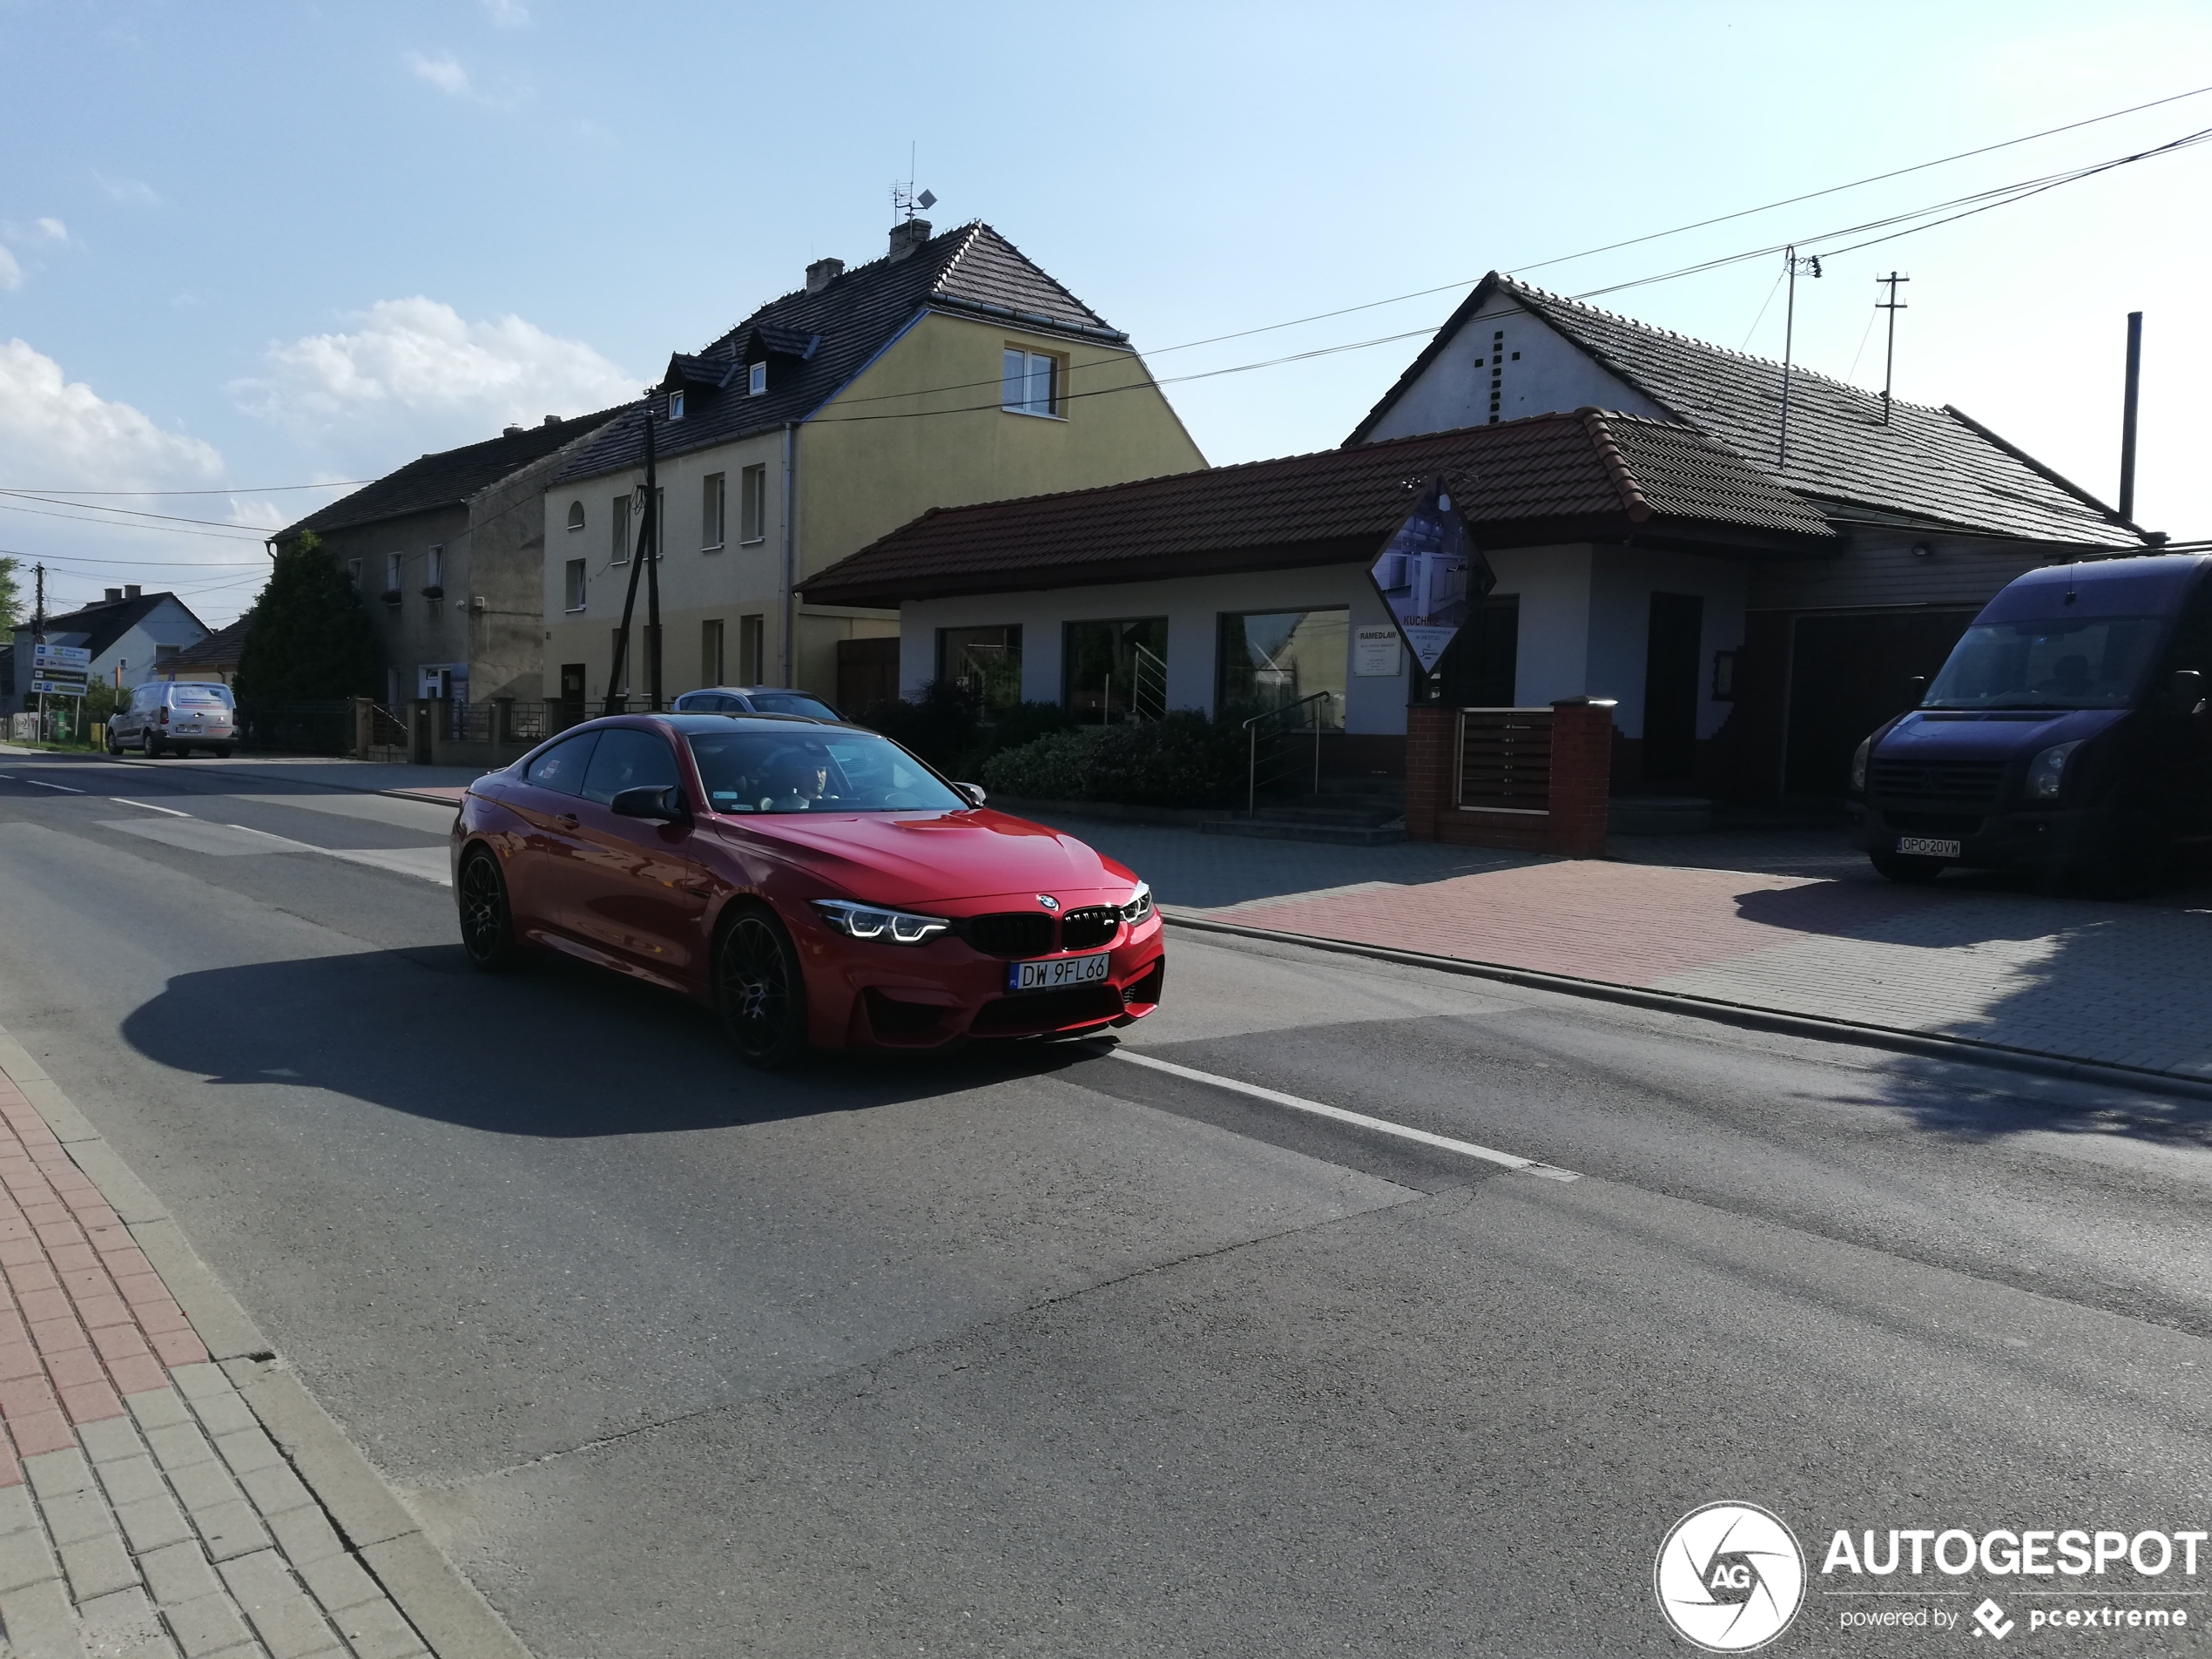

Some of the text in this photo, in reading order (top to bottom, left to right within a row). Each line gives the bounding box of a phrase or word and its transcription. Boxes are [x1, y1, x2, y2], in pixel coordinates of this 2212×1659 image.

[1404, 615, 1440, 627] KUCHNIE
[1360, 631, 1397, 640] RAMEDLAW
[1904, 839, 1926, 851] OPO
[1930, 840, 1959, 853] 20VW
[1022, 956, 1105, 987] DW 9FL66
